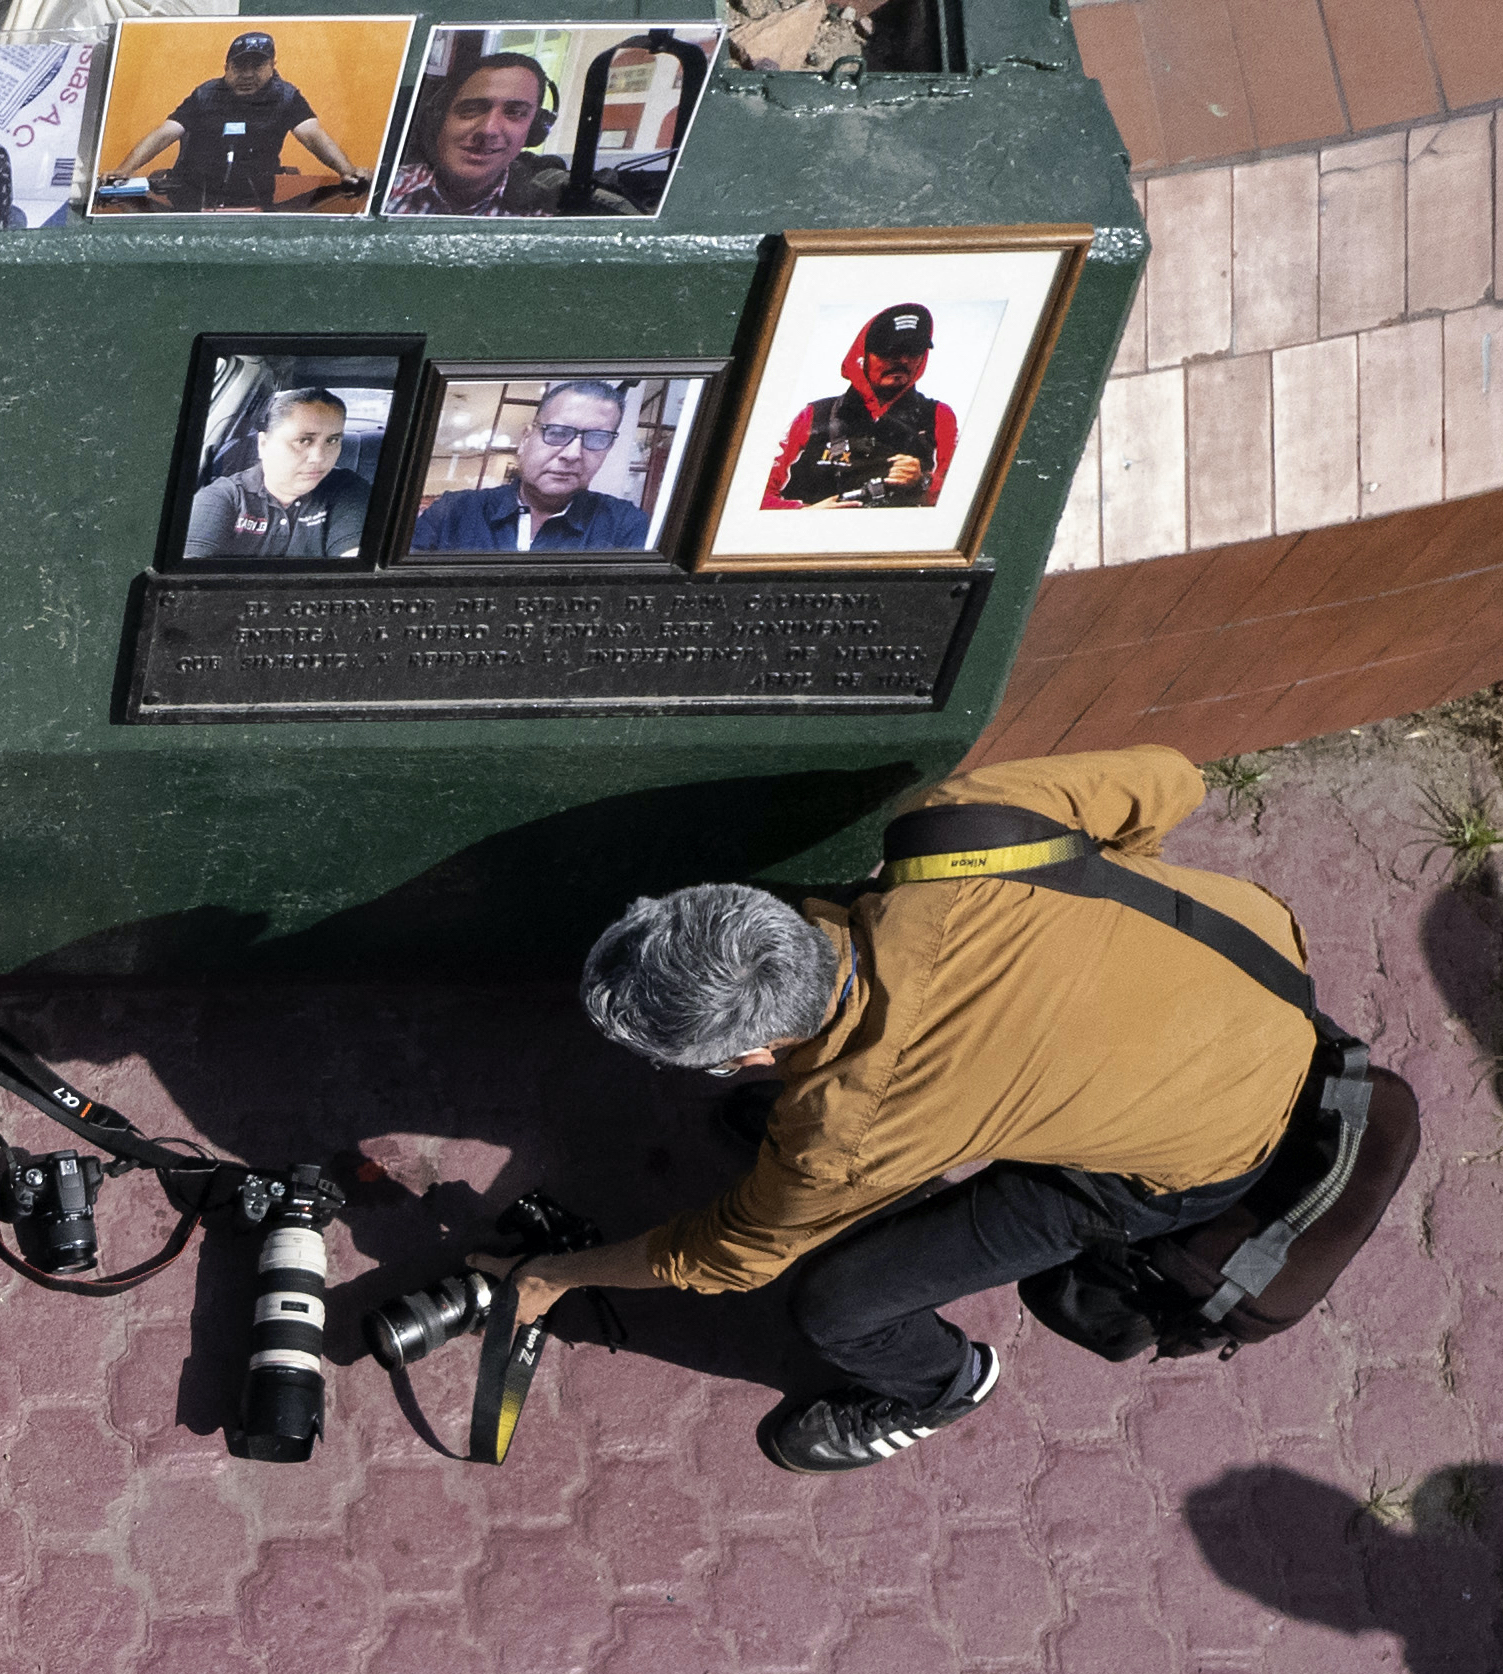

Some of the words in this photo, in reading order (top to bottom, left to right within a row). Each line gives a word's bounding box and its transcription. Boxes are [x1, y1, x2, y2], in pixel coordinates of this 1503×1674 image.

[285, 599, 437, 617] GOBERNADOR
[455, 597, 497, 614] DEL
[514, 596, 602, 613] ESTADO
[626, 595, 657, 611] DE
[744, 593, 884, 610] CALIFORNIA
[234, 627, 339, 645] ENTREGA
[359, 625, 389, 643] AL
[404, 624, 490, 641] PUEBLO
[503, 623, 535, 640] DE
[660, 620, 714, 637] ESTE
[731, 619, 880, 636] MONUMENTO
[176, 654, 223, 673] QUE
[586, 646, 768, 665] INDEPENDENCIA
[787, 645, 819, 663] DE
[951, 857, 987, 868] Nikon
[518, 1348, 536, 1366] Z
